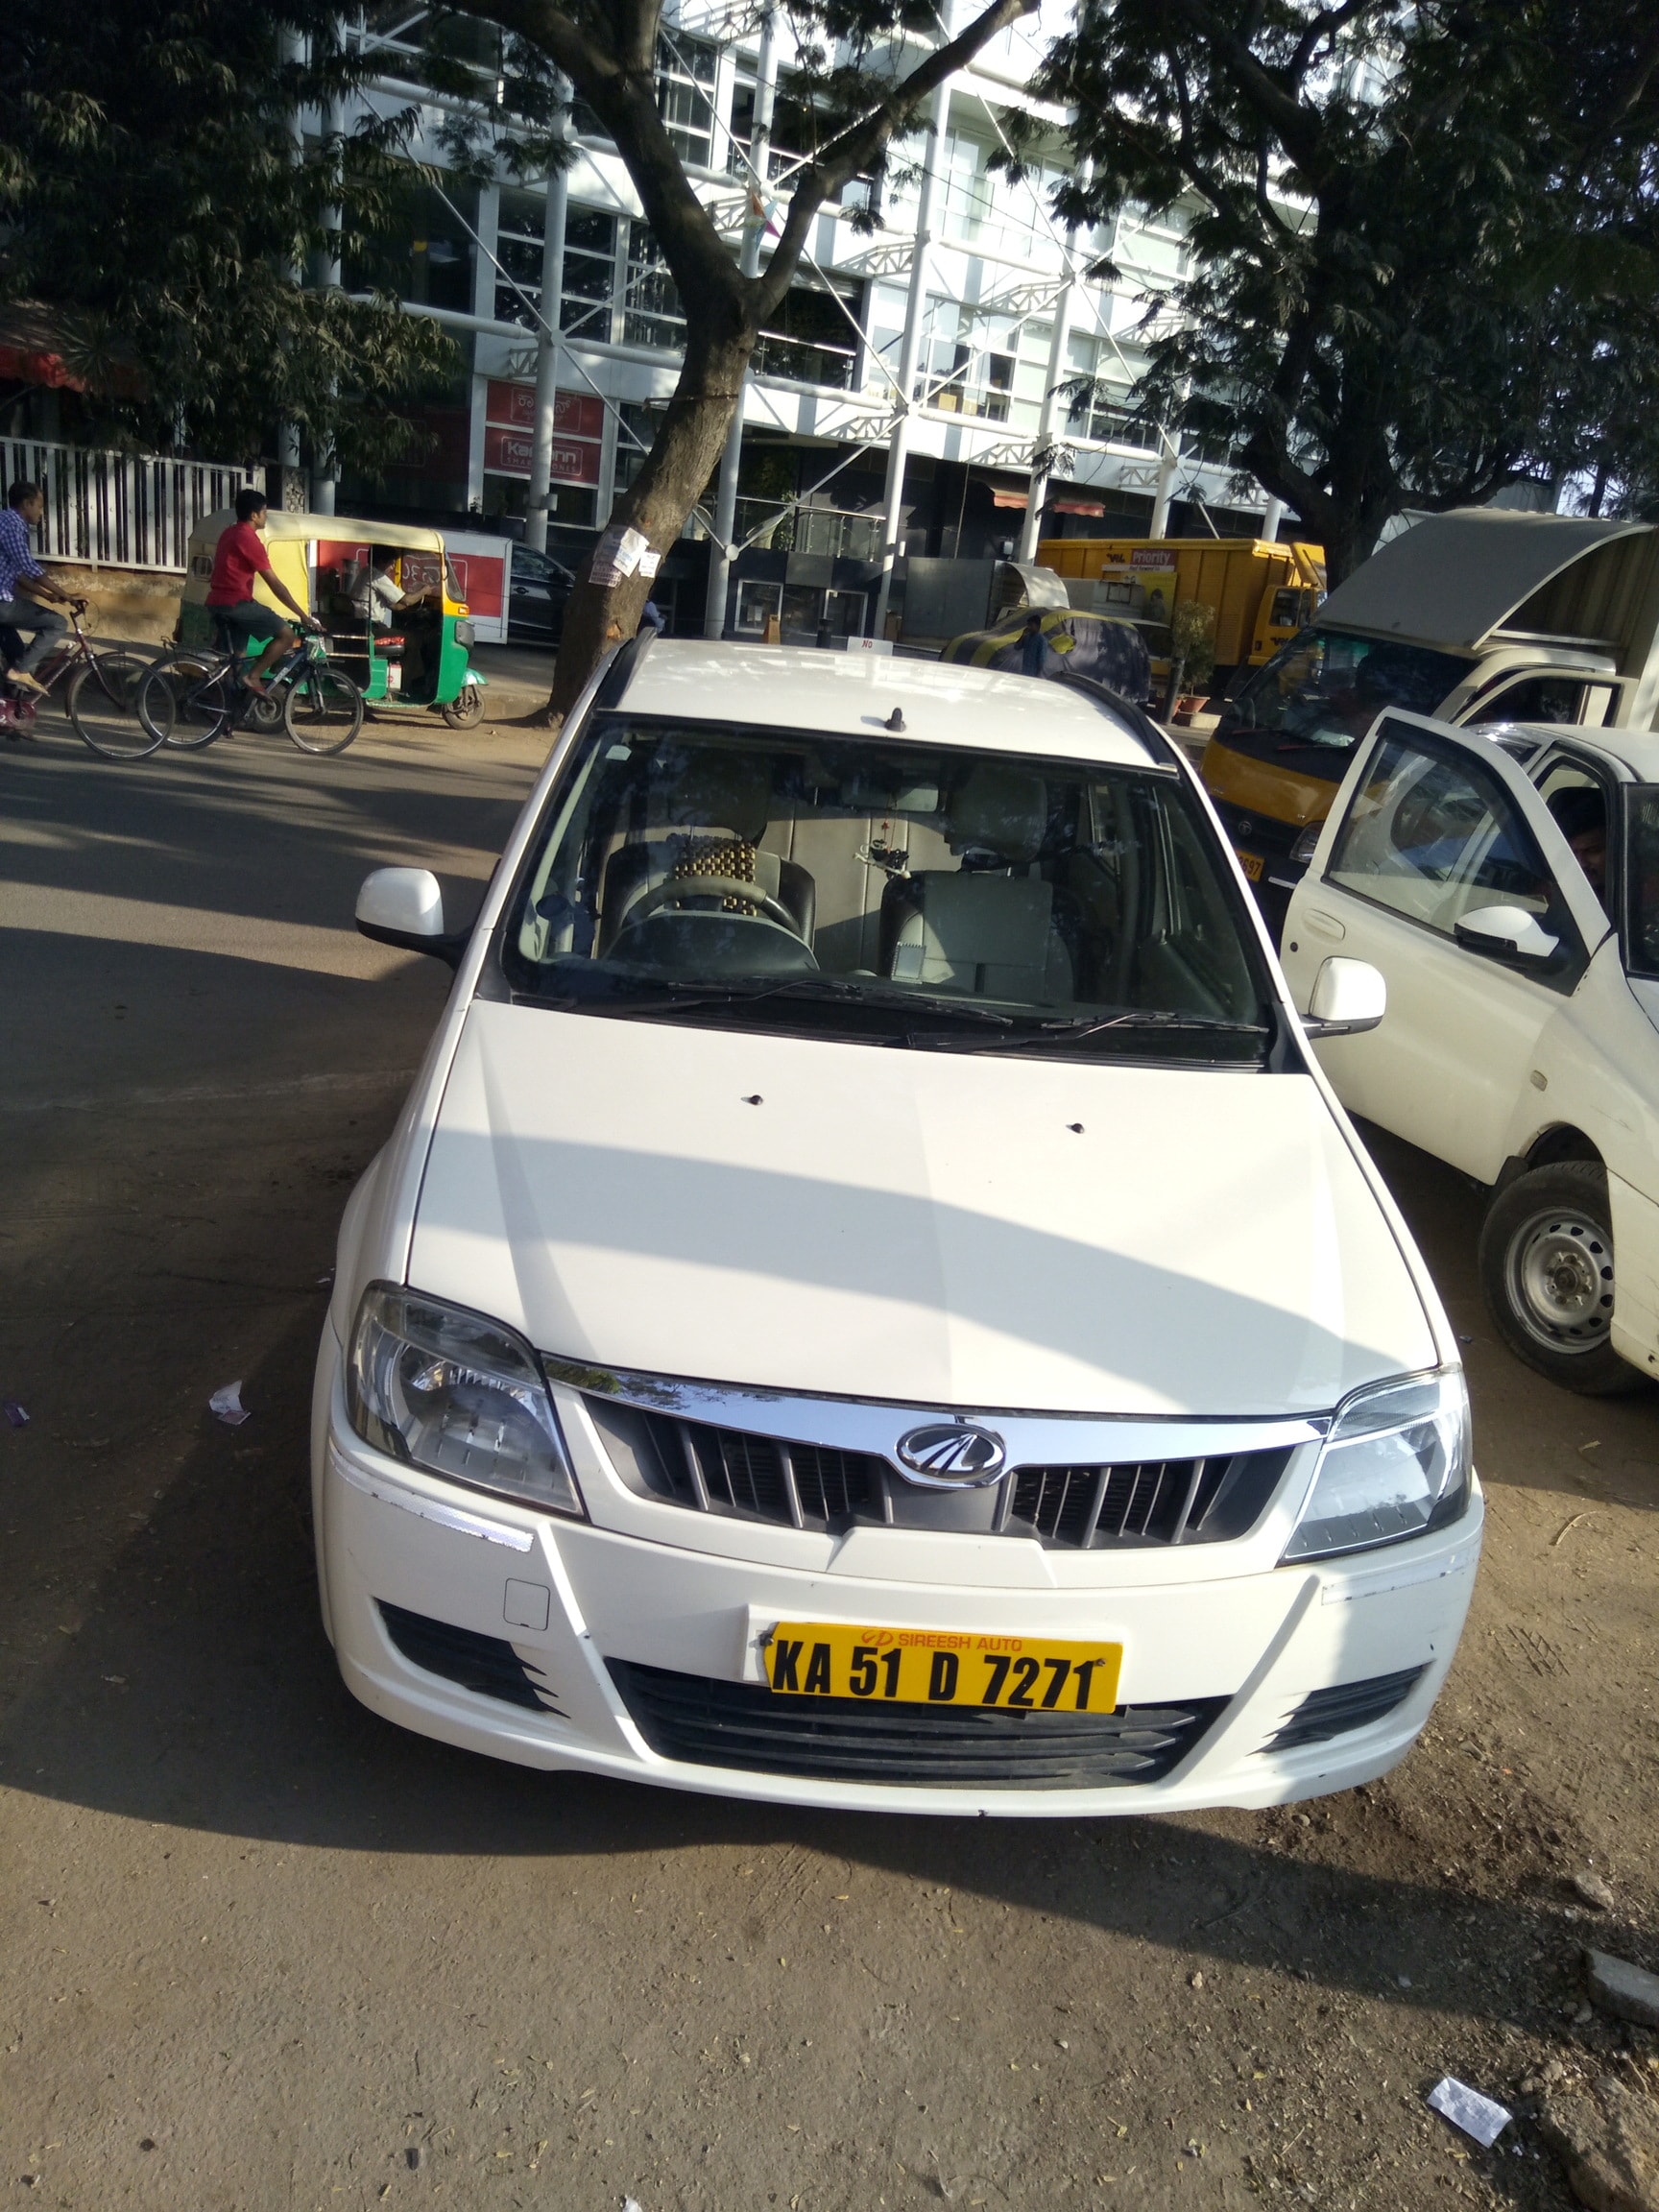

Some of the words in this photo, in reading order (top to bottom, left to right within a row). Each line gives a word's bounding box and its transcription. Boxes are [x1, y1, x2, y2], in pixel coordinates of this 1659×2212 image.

[507, 442, 576, 464] Kann
[507, 458, 576, 472] SMAONES
[1133, 550, 1171, 565] Priority
[861, 639, 873, 649] NO
[898, 1633, 971, 1650] SIREESH
[976, 1637, 1022, 1651] AUTO
[772, 1639, 831, 1695] KA
[849, 1647, 902, 1698] 51
[927, 1651, 959, 1701] D
[981, 1655, 1094, 1710] 7271
